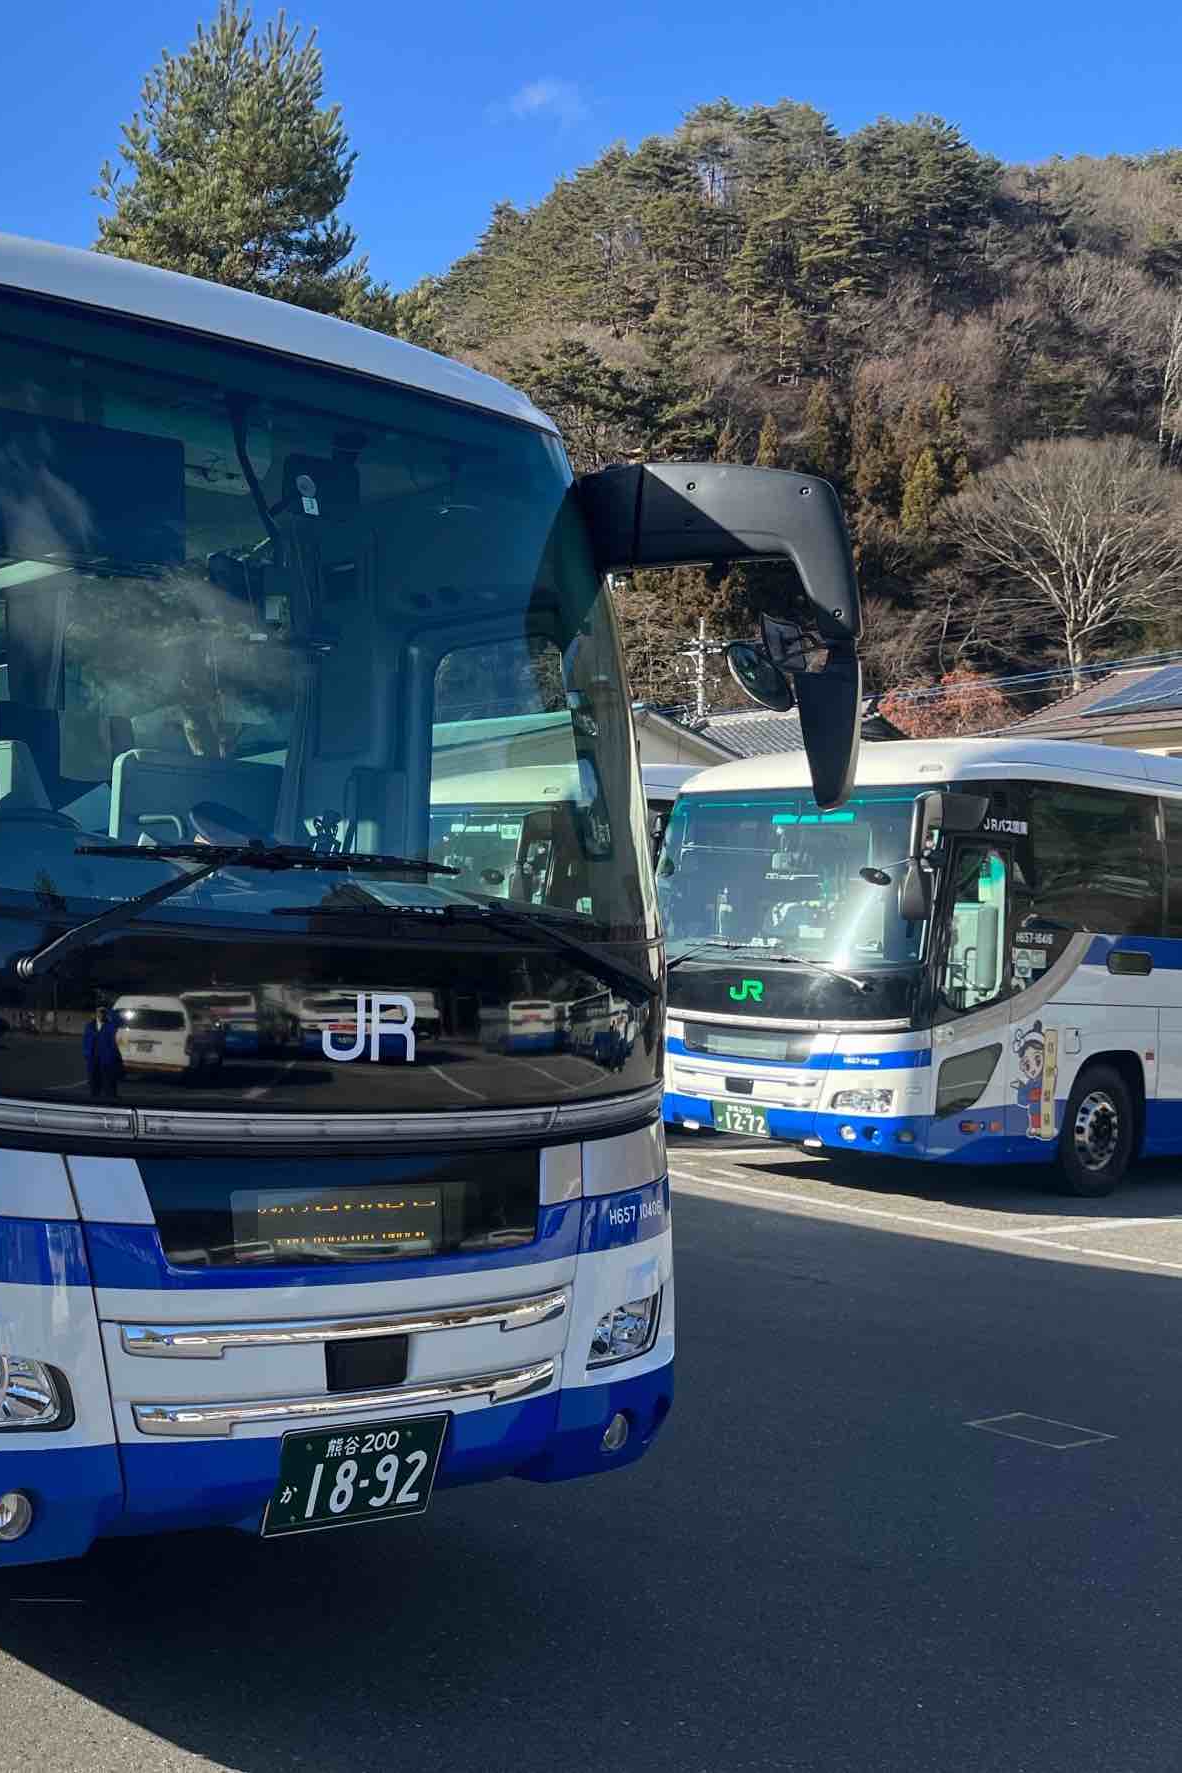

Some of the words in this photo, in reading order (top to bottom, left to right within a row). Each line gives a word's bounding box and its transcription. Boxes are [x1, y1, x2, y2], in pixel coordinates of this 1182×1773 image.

[983, 817, 1028, 835] JRバス
[729, 979, 764, 1002] JR
[321, 992, 416, 1062] JR
[724, 1111, 767, 1134] 12-72
[279, 1485, 299, 1505] か
[304, 1449, 428, 1519] 18-92
